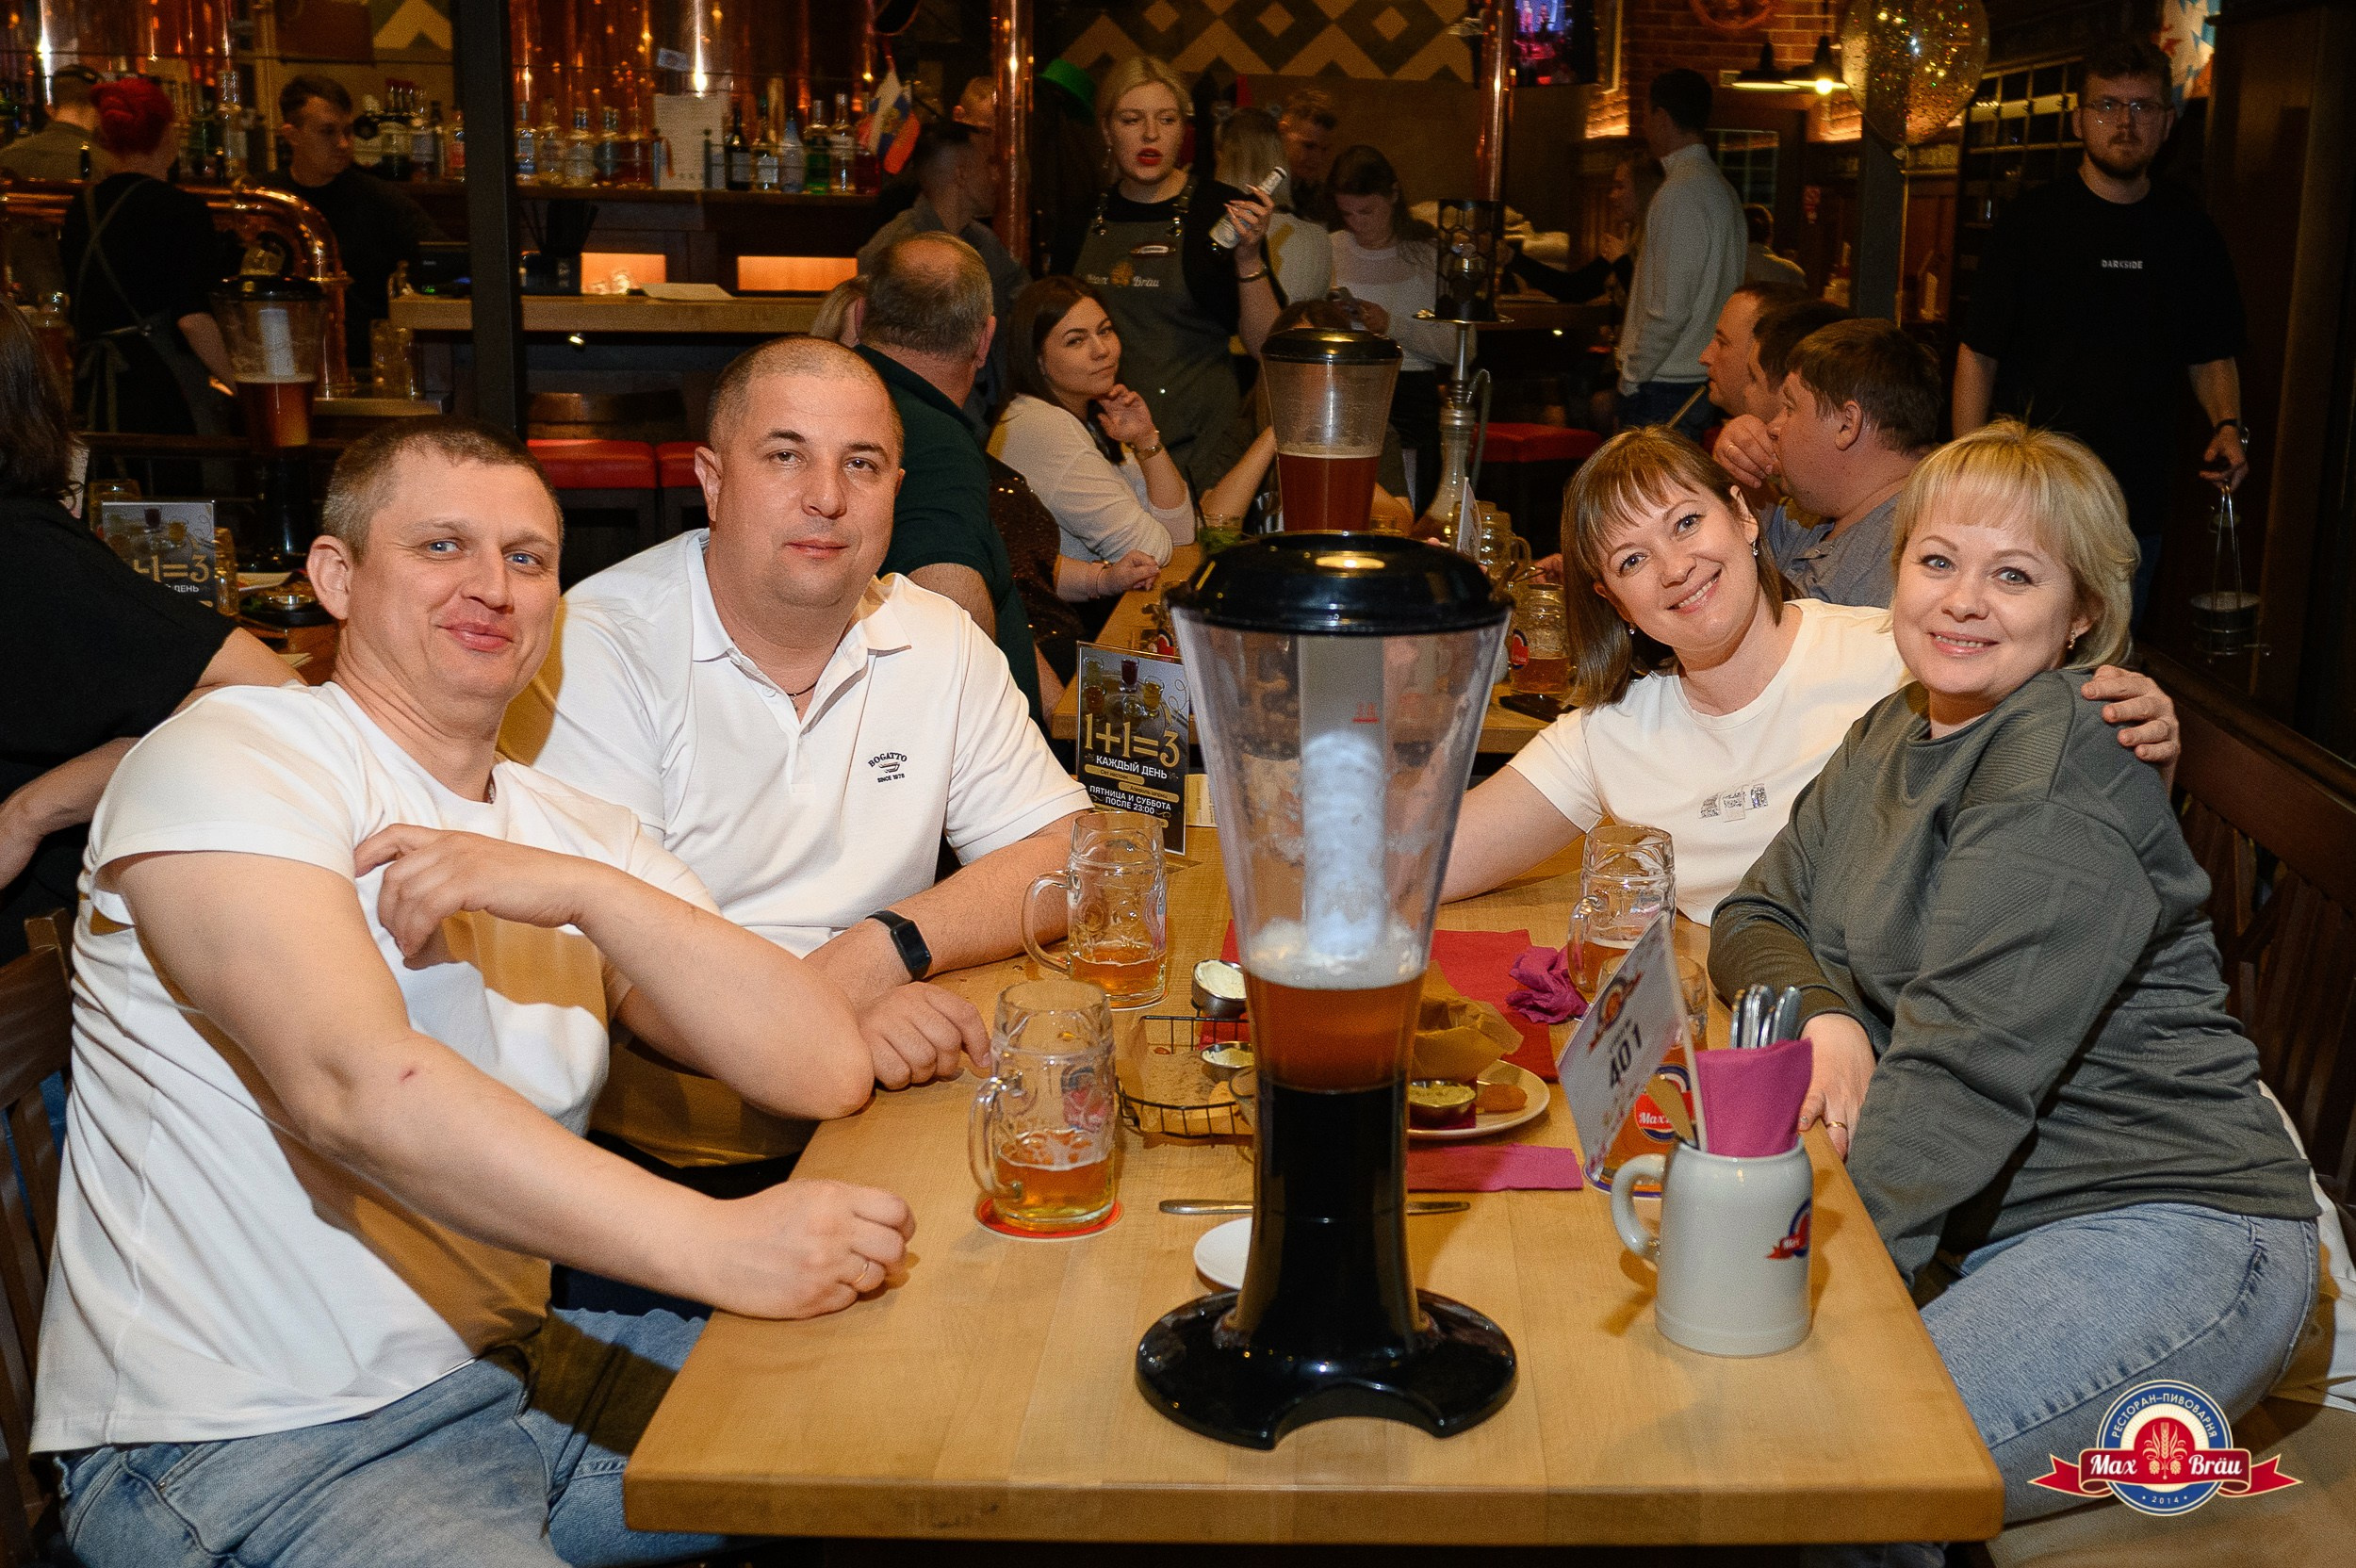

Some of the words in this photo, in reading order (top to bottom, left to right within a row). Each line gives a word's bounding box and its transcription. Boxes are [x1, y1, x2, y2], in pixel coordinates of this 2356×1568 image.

[2102, 259, 2143, 270] DARKSIDE
[134, 553, 209, 583] +1=3
[1085, 713, 1180, 768] 1+1=3
[868, 752, 908, 768] BOGATTO
[1096, 755, 1139, 773] КАЖДЫЙ
[1141, 765, 1168, 779] ДЕНЬ
[1089, 785, 1126, 800] ПЯТНИЦА
[1136, 796, 1171, 810] СУББОТА
[1104, 796, 1132, 809] ПОСЛЕ
[1133, 803, 1154, 814] 23:00
[1610, 1023, 1643, 1088] 401
